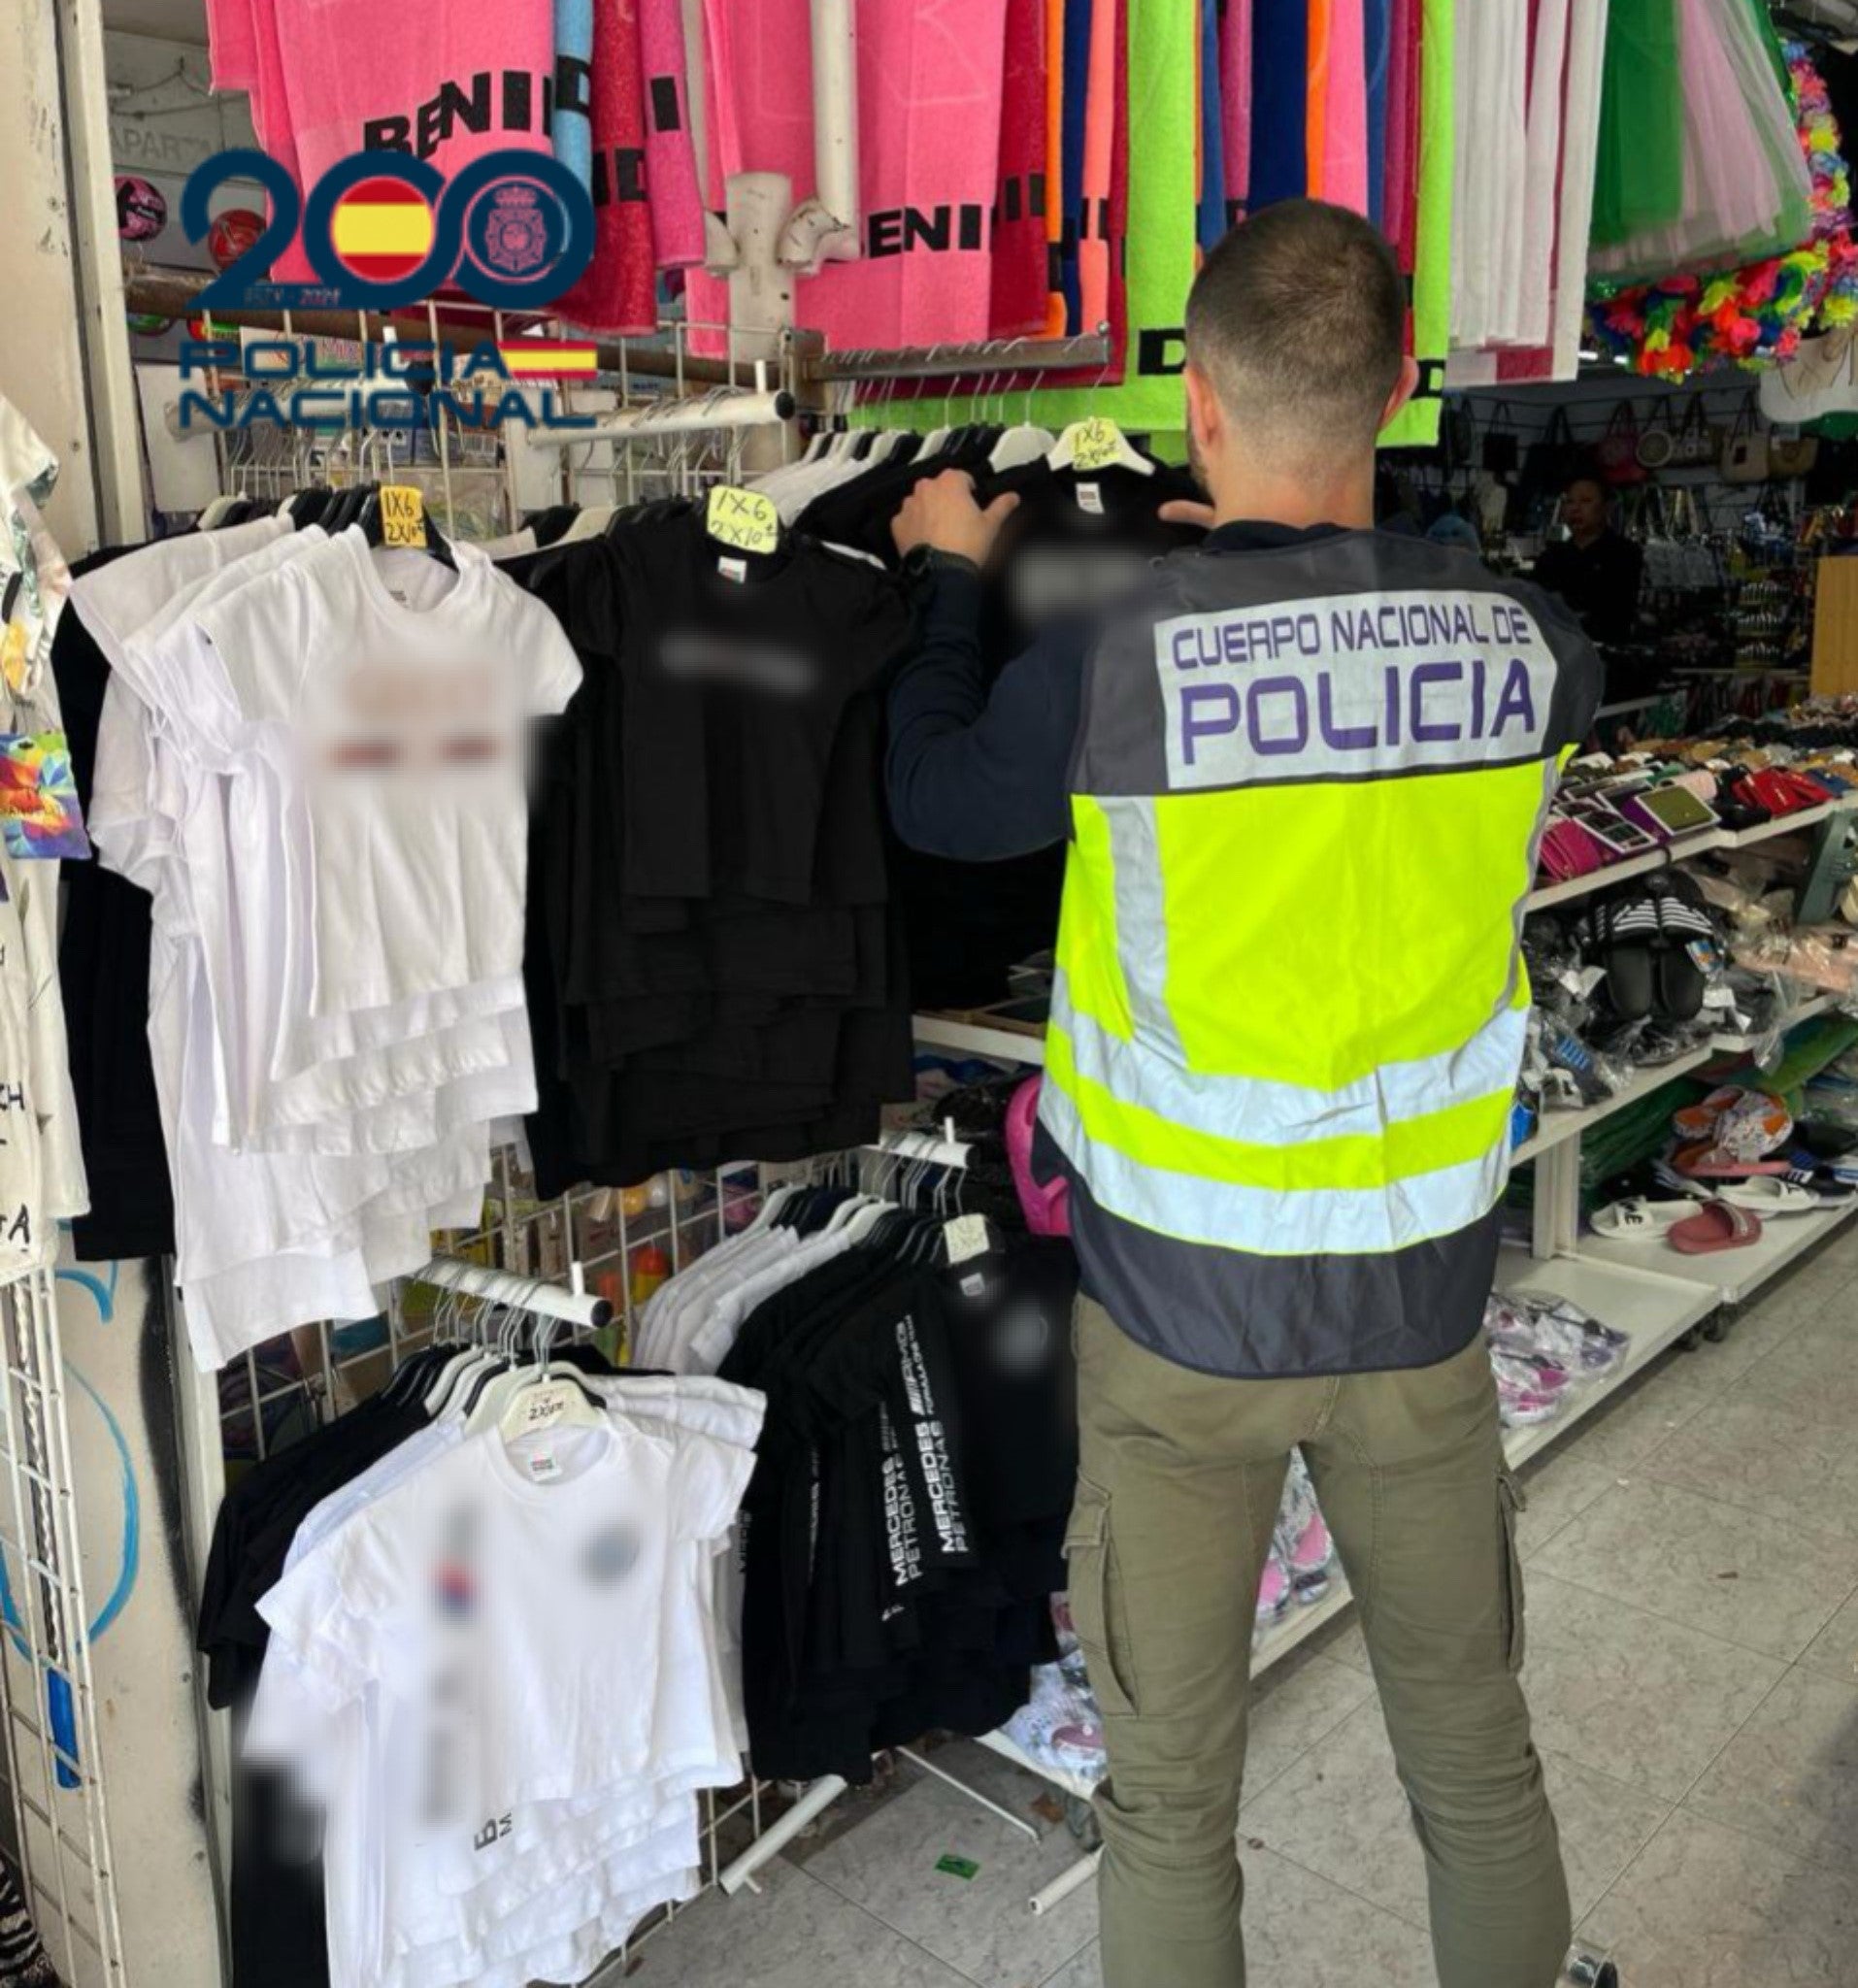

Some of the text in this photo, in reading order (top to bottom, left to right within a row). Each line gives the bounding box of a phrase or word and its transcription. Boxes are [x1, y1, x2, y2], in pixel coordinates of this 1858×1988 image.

[364, 70, 552, 160] BENI
[860, 205, 997, 259] ENI
[1173, 604, 1532, 671] CUERPO NACIONAL DE
[1179, 657, 1535, 765] POLICIA
